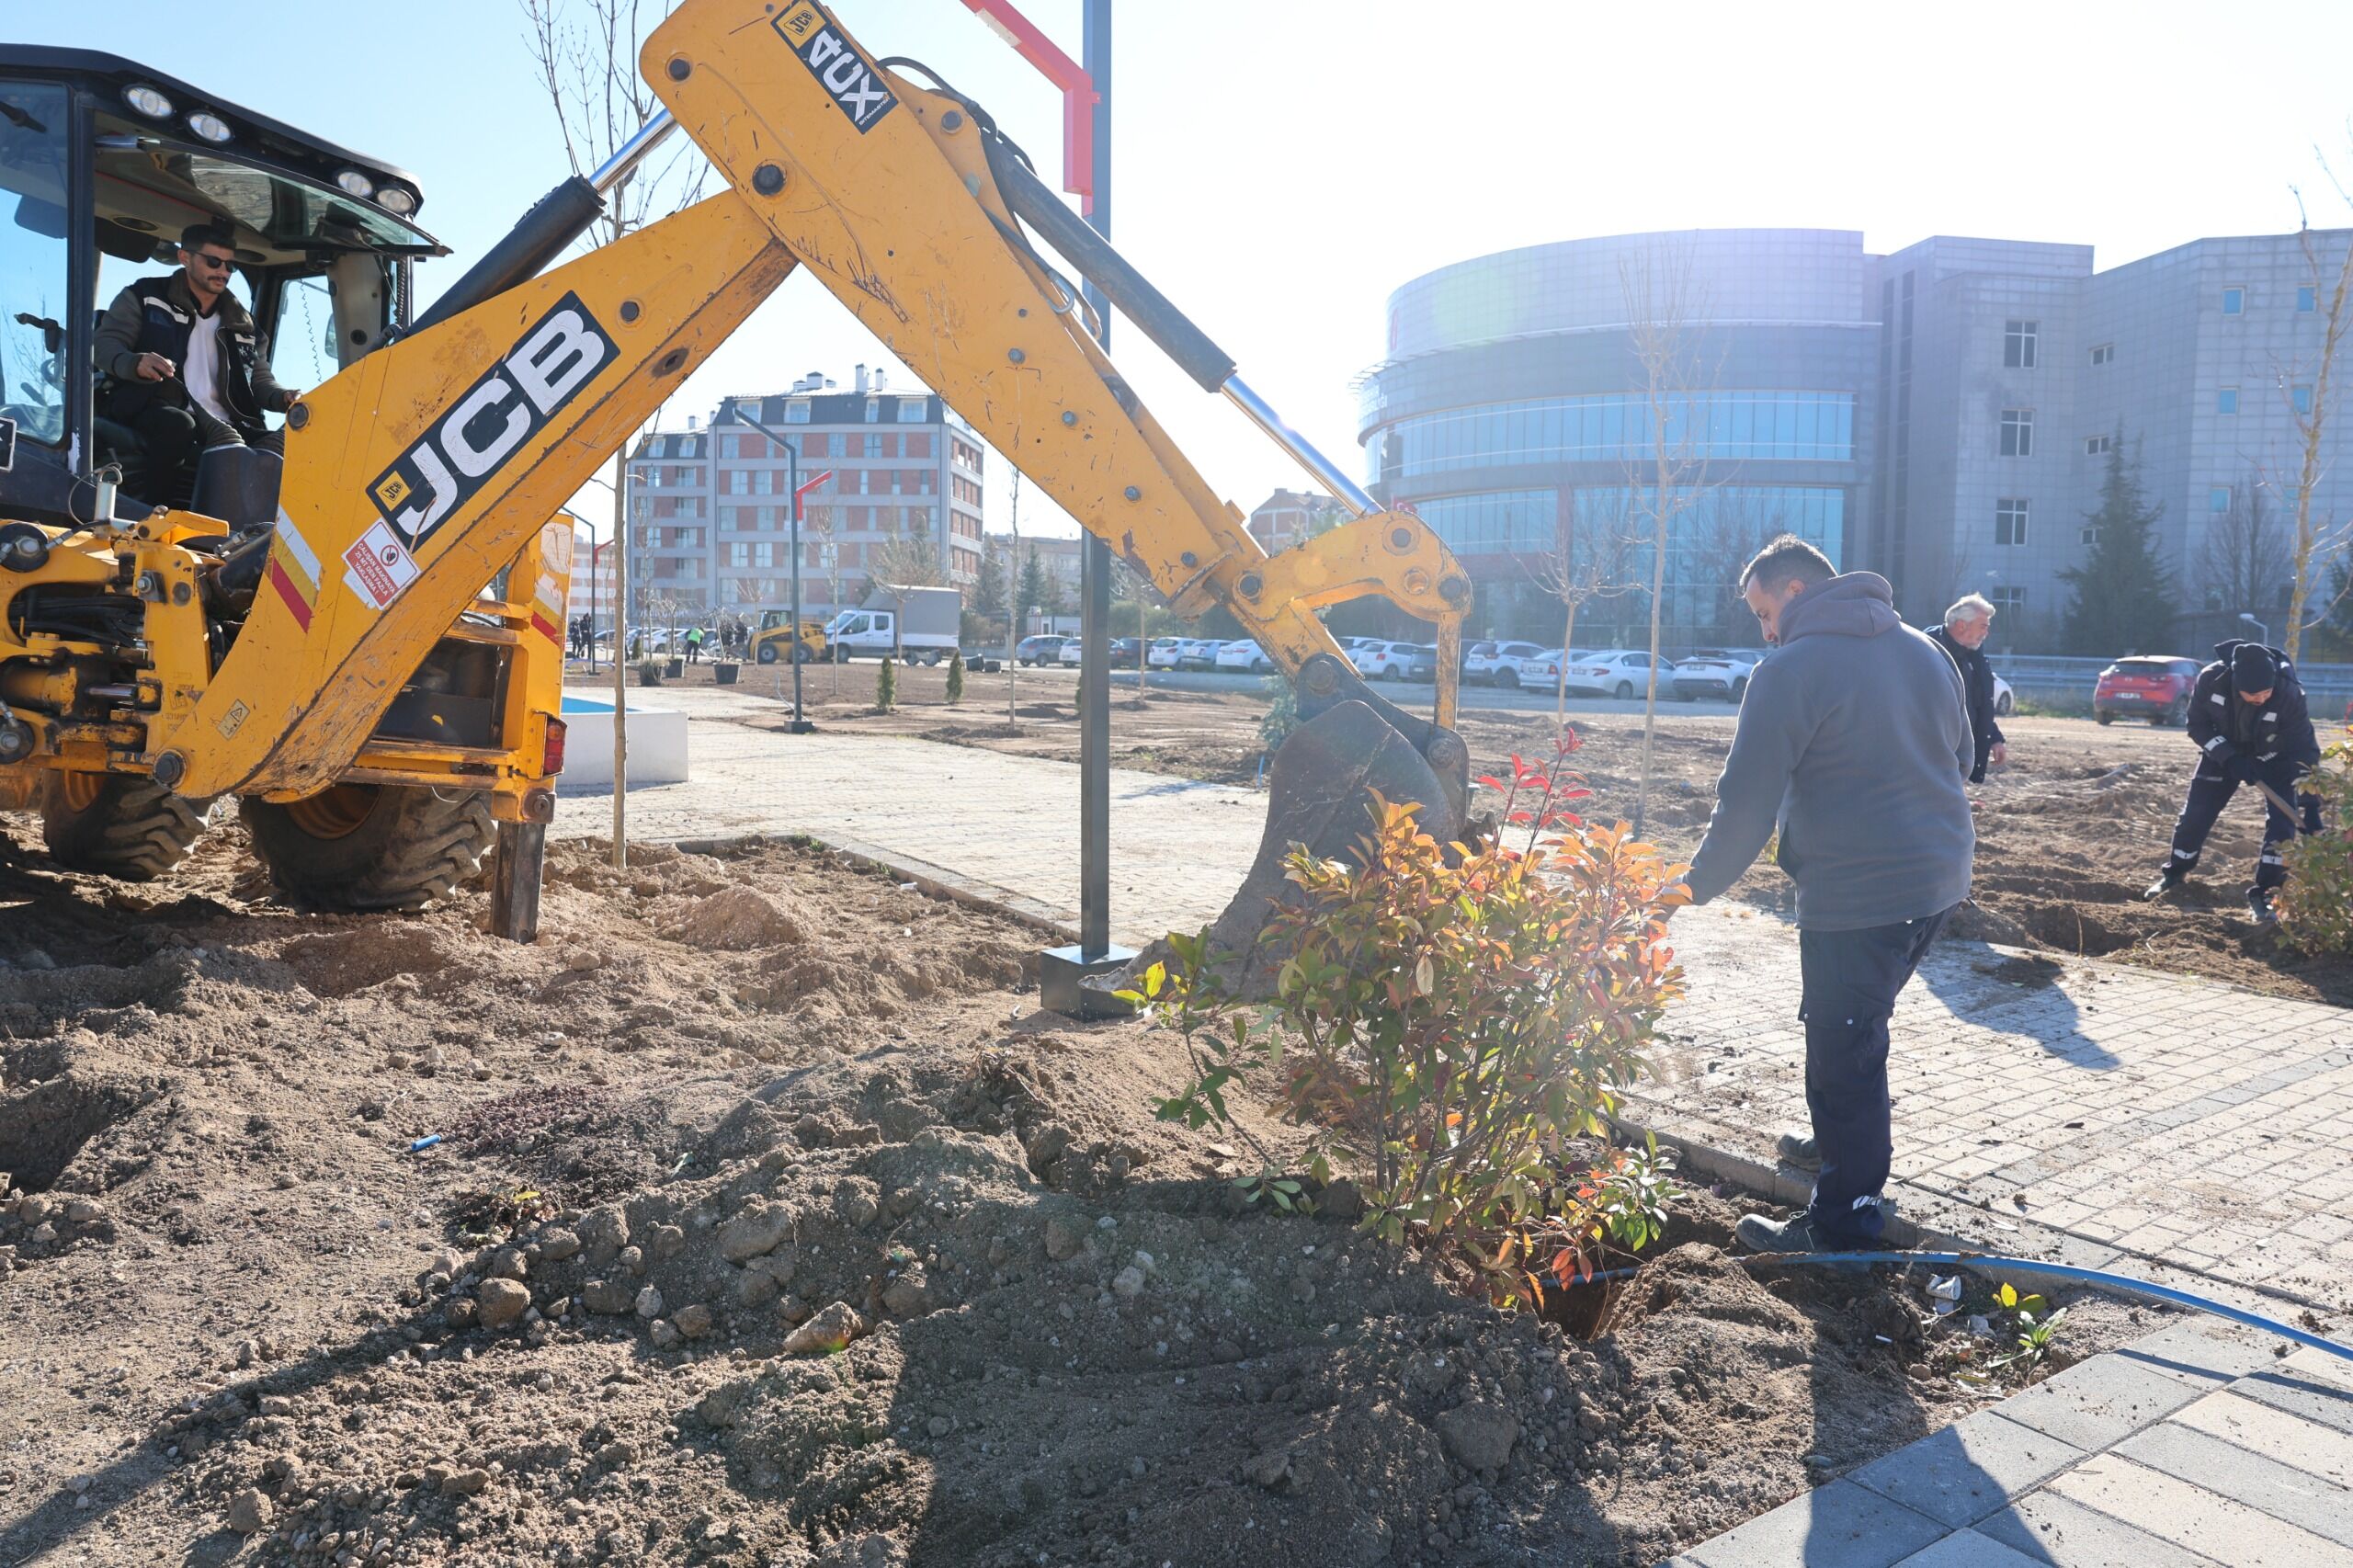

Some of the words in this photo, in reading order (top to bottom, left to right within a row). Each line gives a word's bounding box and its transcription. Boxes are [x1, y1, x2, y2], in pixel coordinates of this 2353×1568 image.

[790, 11, 813, 34] JCB
[396, 310, 604, 536] JCB
[385, 483, 403, 499] JCB
